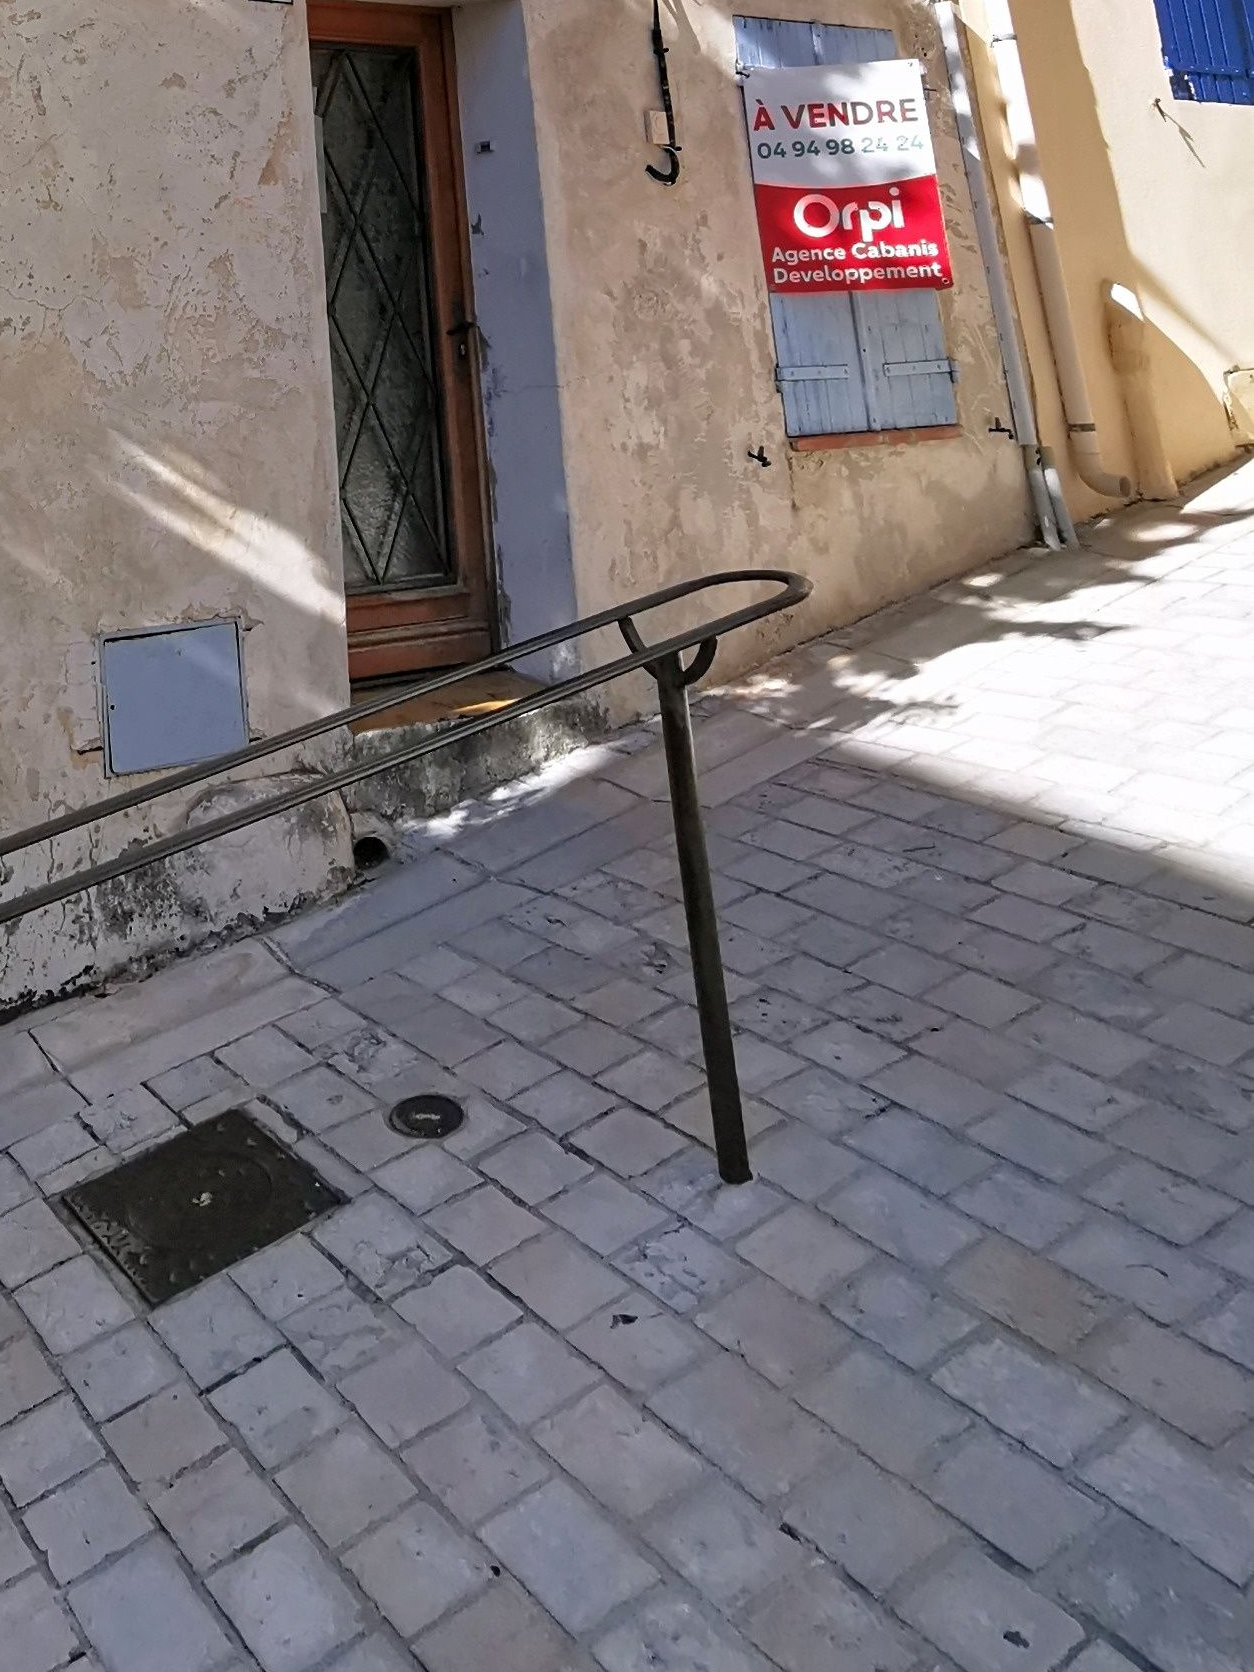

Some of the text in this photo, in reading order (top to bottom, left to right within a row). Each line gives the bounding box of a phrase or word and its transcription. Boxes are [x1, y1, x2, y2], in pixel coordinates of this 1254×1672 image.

[753, 98, 919, 131] À VENDRE
[757, 135, 924, 159] 04 94 98 24 24
[793, 187, 905, 242] Orpi
[771, 239, 939, 265] Agence Cabanis
[774, 262, 943, 284] Developpement
